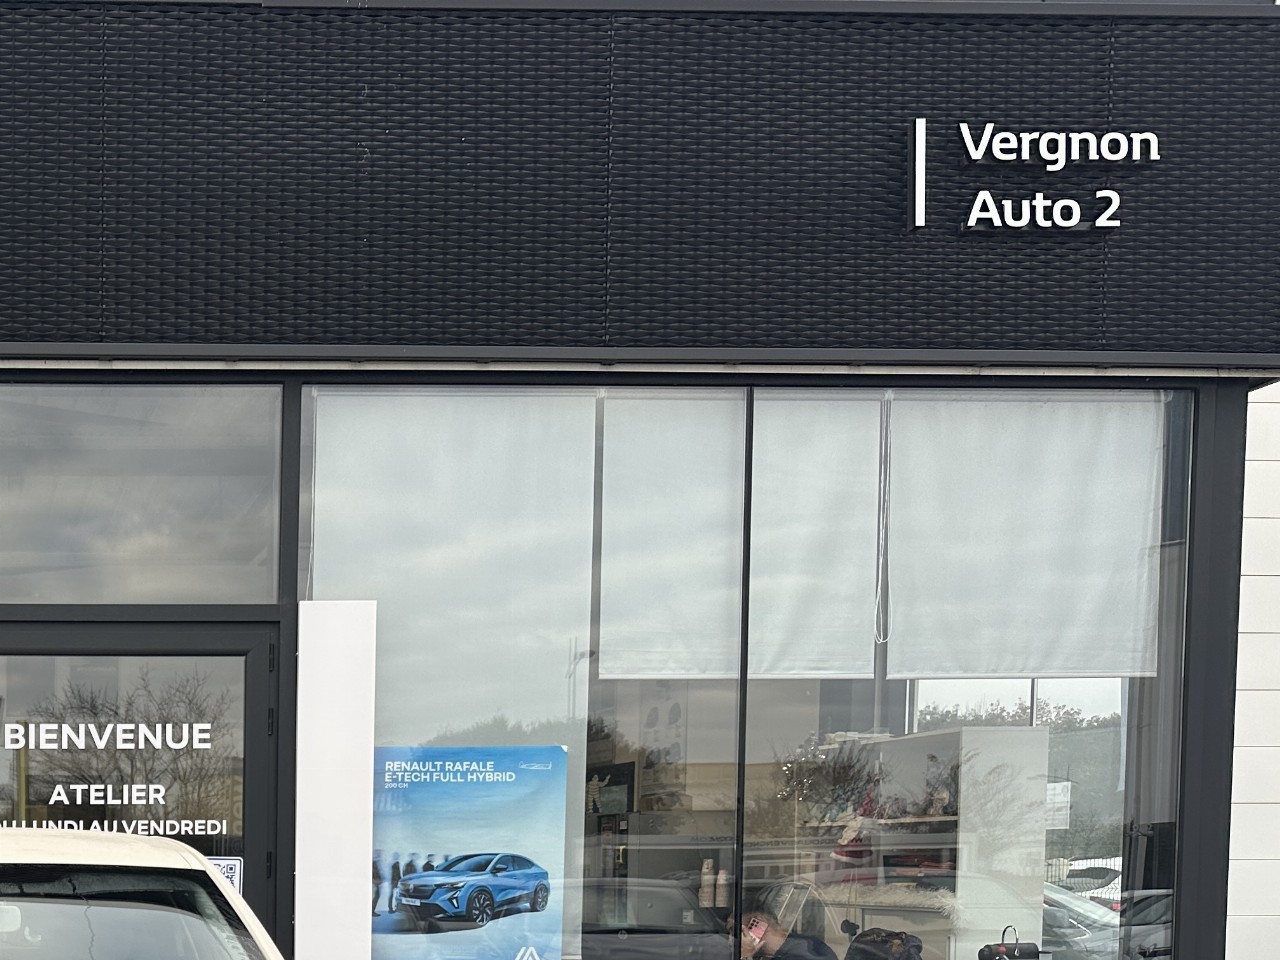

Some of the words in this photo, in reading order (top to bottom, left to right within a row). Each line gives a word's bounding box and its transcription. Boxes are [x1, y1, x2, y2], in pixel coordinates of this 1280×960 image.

[959, 122, 1161, 172] Vergnon
[966, 190, 1081, 228] Auto
[1095, 189, 1121, 227] 2
[4, 723, 212, 750] BIENVENUE
[385, 761, 443, 772] RENAULT
[445, 761, 495, 772] RAFALE
[384, 772, 430, 783] E-TECH
[432, 772, 464, 782] FULL
[467, 772, 516, 782] HYBRID
[48, 784, 166, 805] ATELIER
[122, 820, 227, 836] VENDREDI
